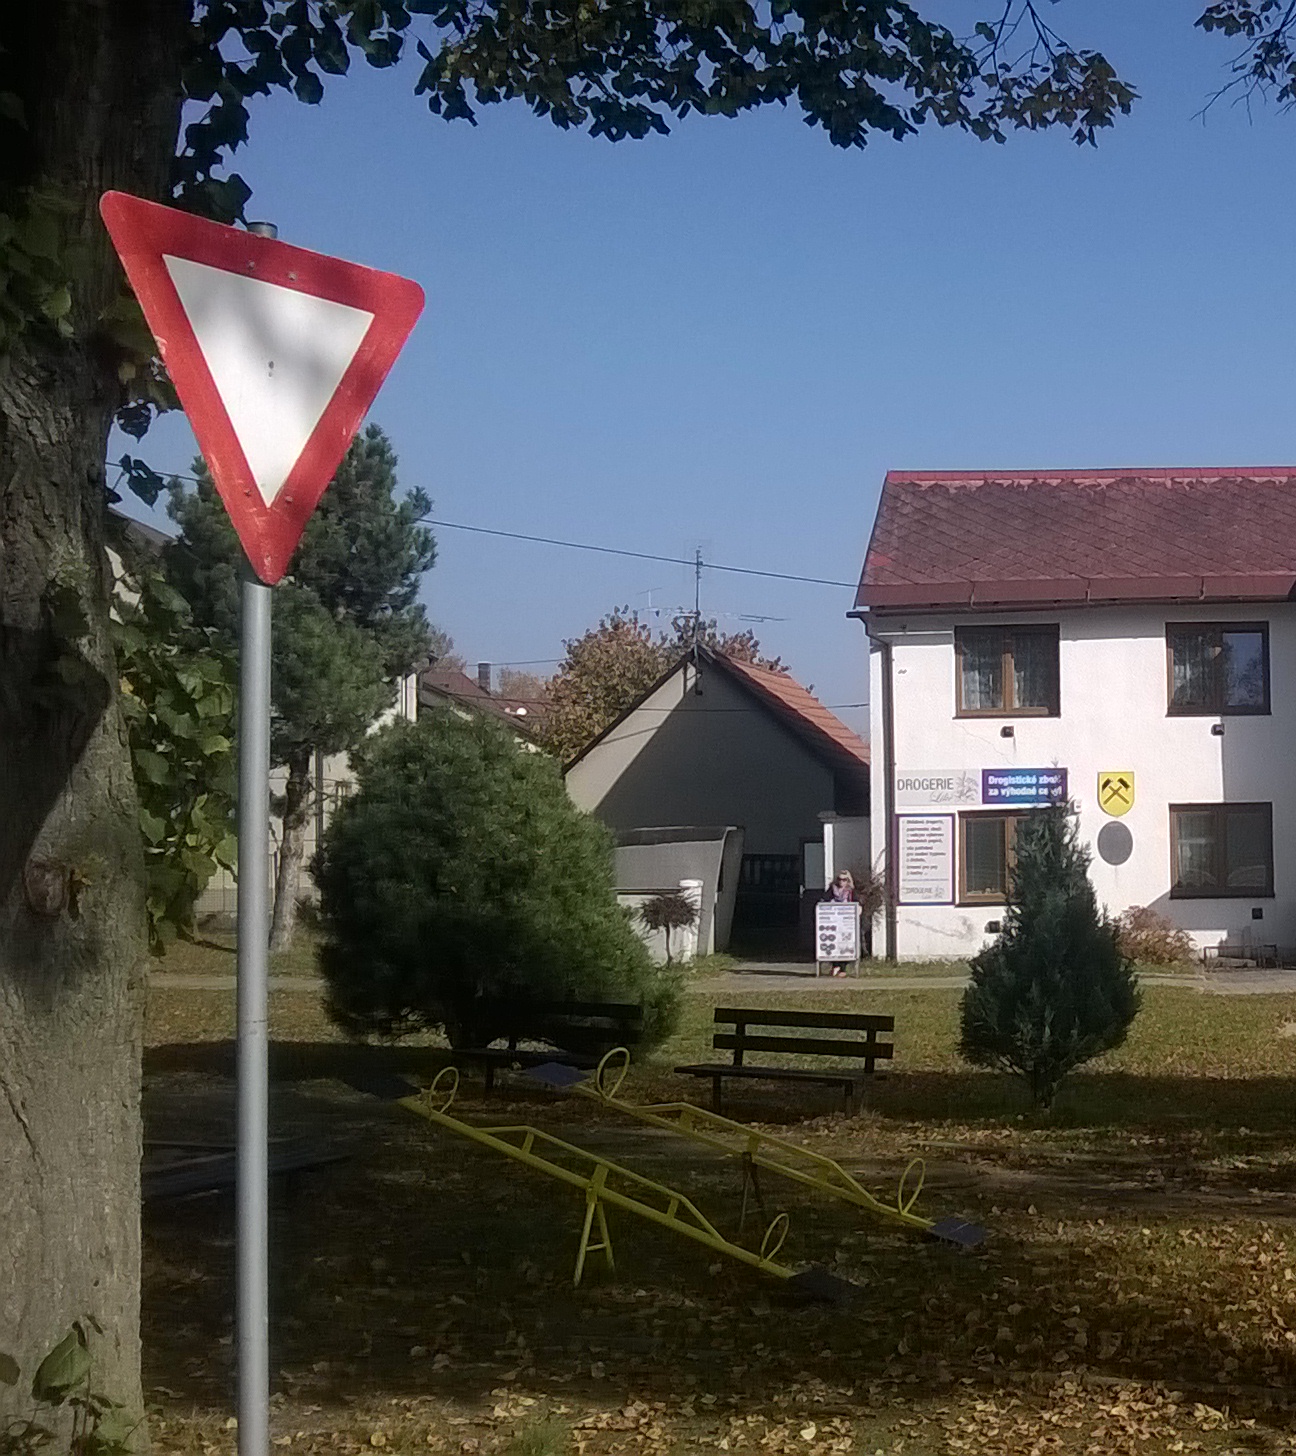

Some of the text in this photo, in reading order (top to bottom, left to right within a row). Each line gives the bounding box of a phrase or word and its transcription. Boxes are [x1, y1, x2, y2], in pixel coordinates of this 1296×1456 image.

[897, 778, 954, 791] DROGERIE
[988, 775, 1037, 787] Drogistické
[988, 787, 999, 796] za
[1001, 786, 1037, 798] výhodné
